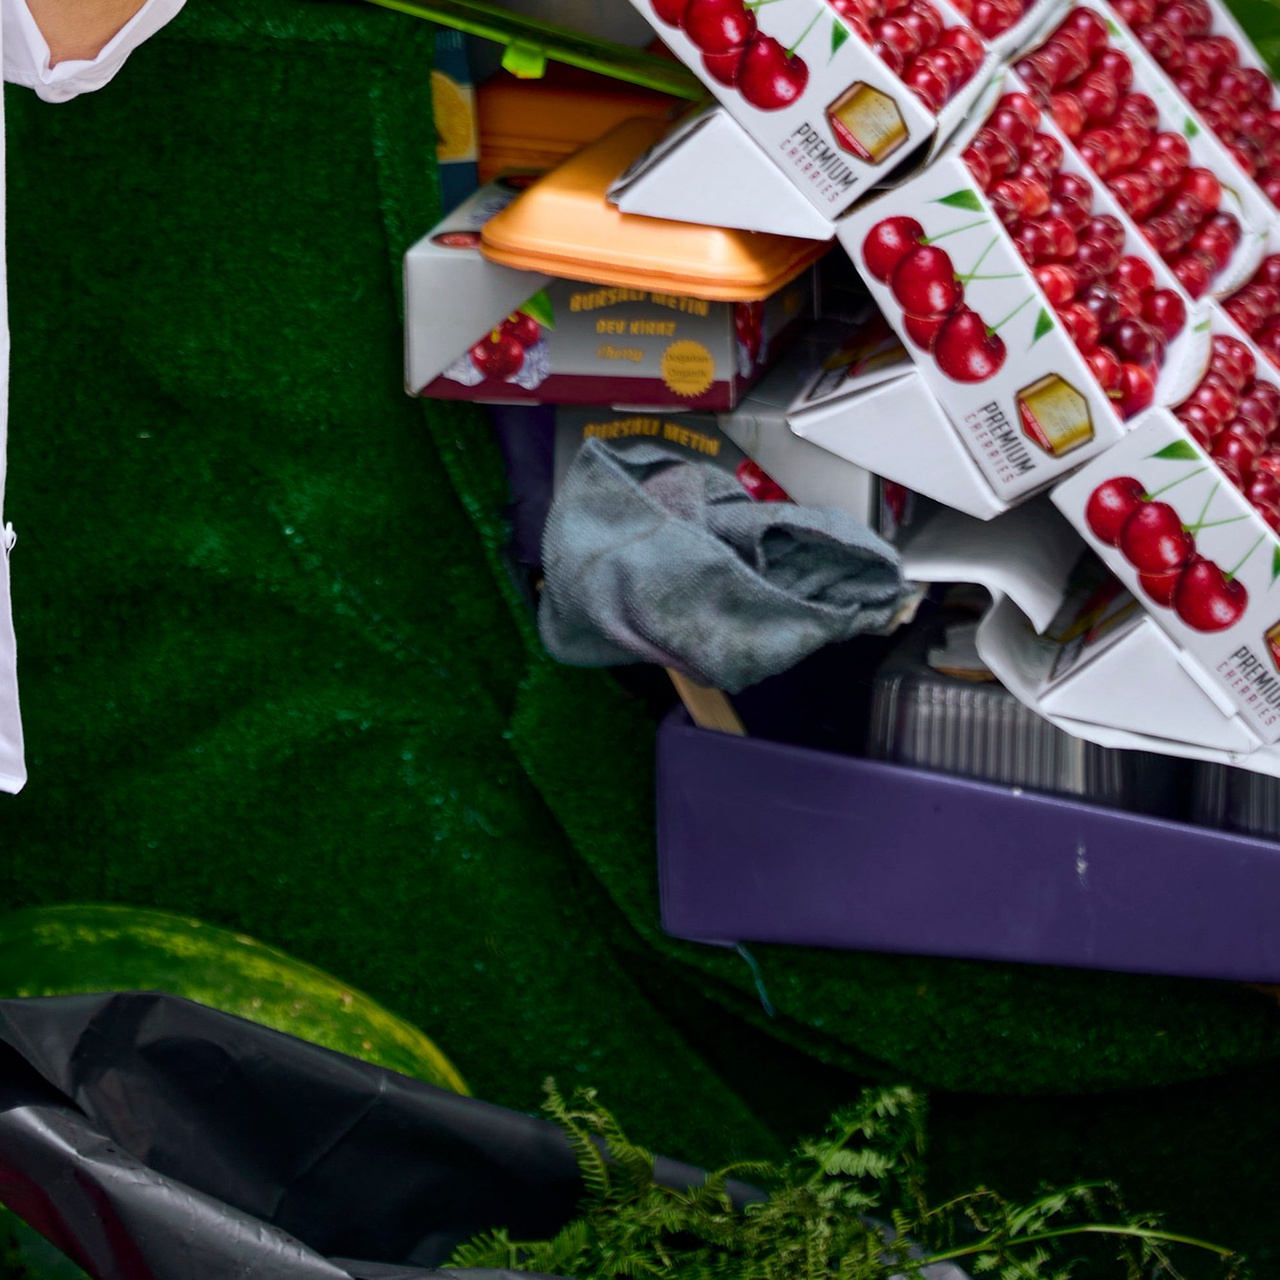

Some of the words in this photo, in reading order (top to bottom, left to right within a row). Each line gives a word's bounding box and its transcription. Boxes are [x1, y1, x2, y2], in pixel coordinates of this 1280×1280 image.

[779, 139, 840, 203] CHERRIES
[790, 121, 859, 193] PREMIUM
[964, 412, 1015, 484] CHERRIES
[976, 400, 1037, 477] PREMIUM
[1216, 661, 1277, 727] CHERRIES
[1227, 645, 1280, 716] PREMIU
